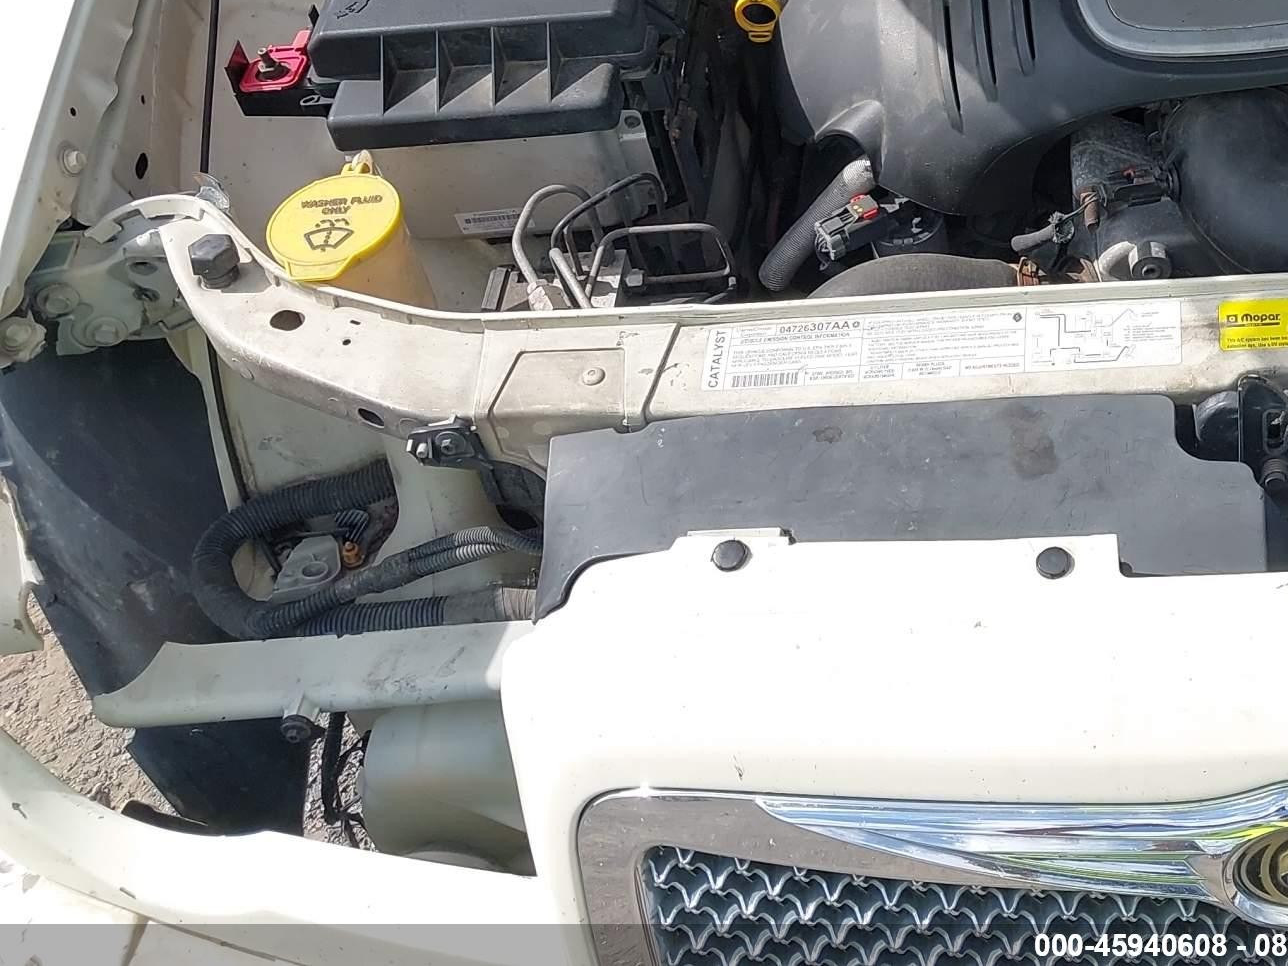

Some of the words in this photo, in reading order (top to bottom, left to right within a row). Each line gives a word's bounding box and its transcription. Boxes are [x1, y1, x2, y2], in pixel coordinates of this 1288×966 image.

[301, 197, 348, 209] WASHER
[350, 194, 383, 205] FLUID
[321, 205, 350, 215] ONLY
[780, 321, 850, 334] 04726307AA
[708, 330, 727, 388] CATALYST
